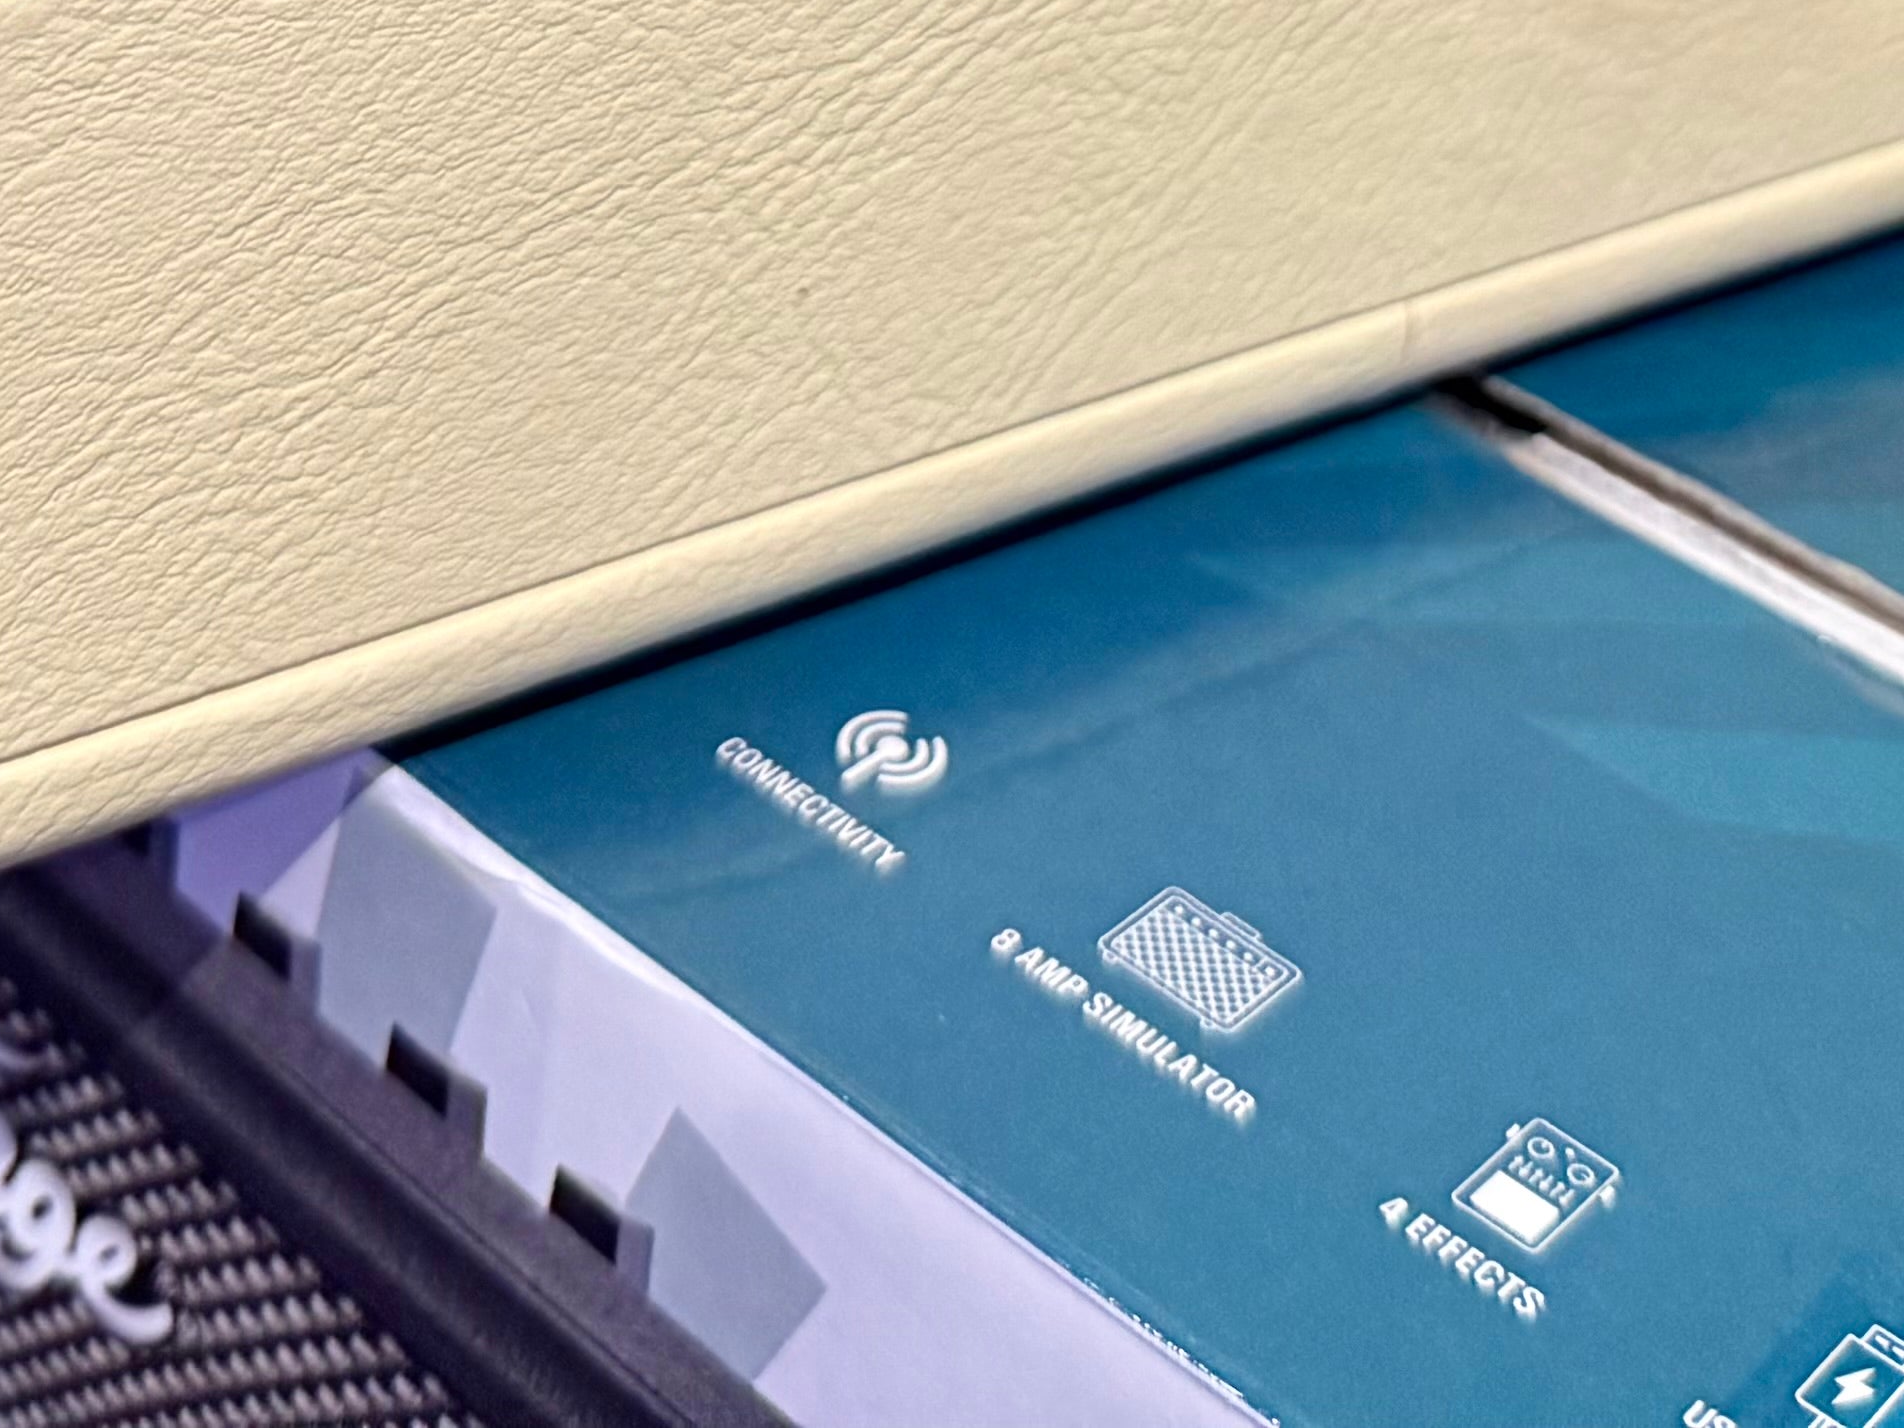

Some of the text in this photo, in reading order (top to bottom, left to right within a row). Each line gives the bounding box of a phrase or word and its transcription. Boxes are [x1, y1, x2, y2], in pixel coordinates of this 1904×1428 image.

[715, 736, 905, 874] CONNECTIVITY
[990, 927, 1257, 1124] 8 AMP SIMULATOR
[1379, 1195, 1548, 1324] 4 EFFECTS
